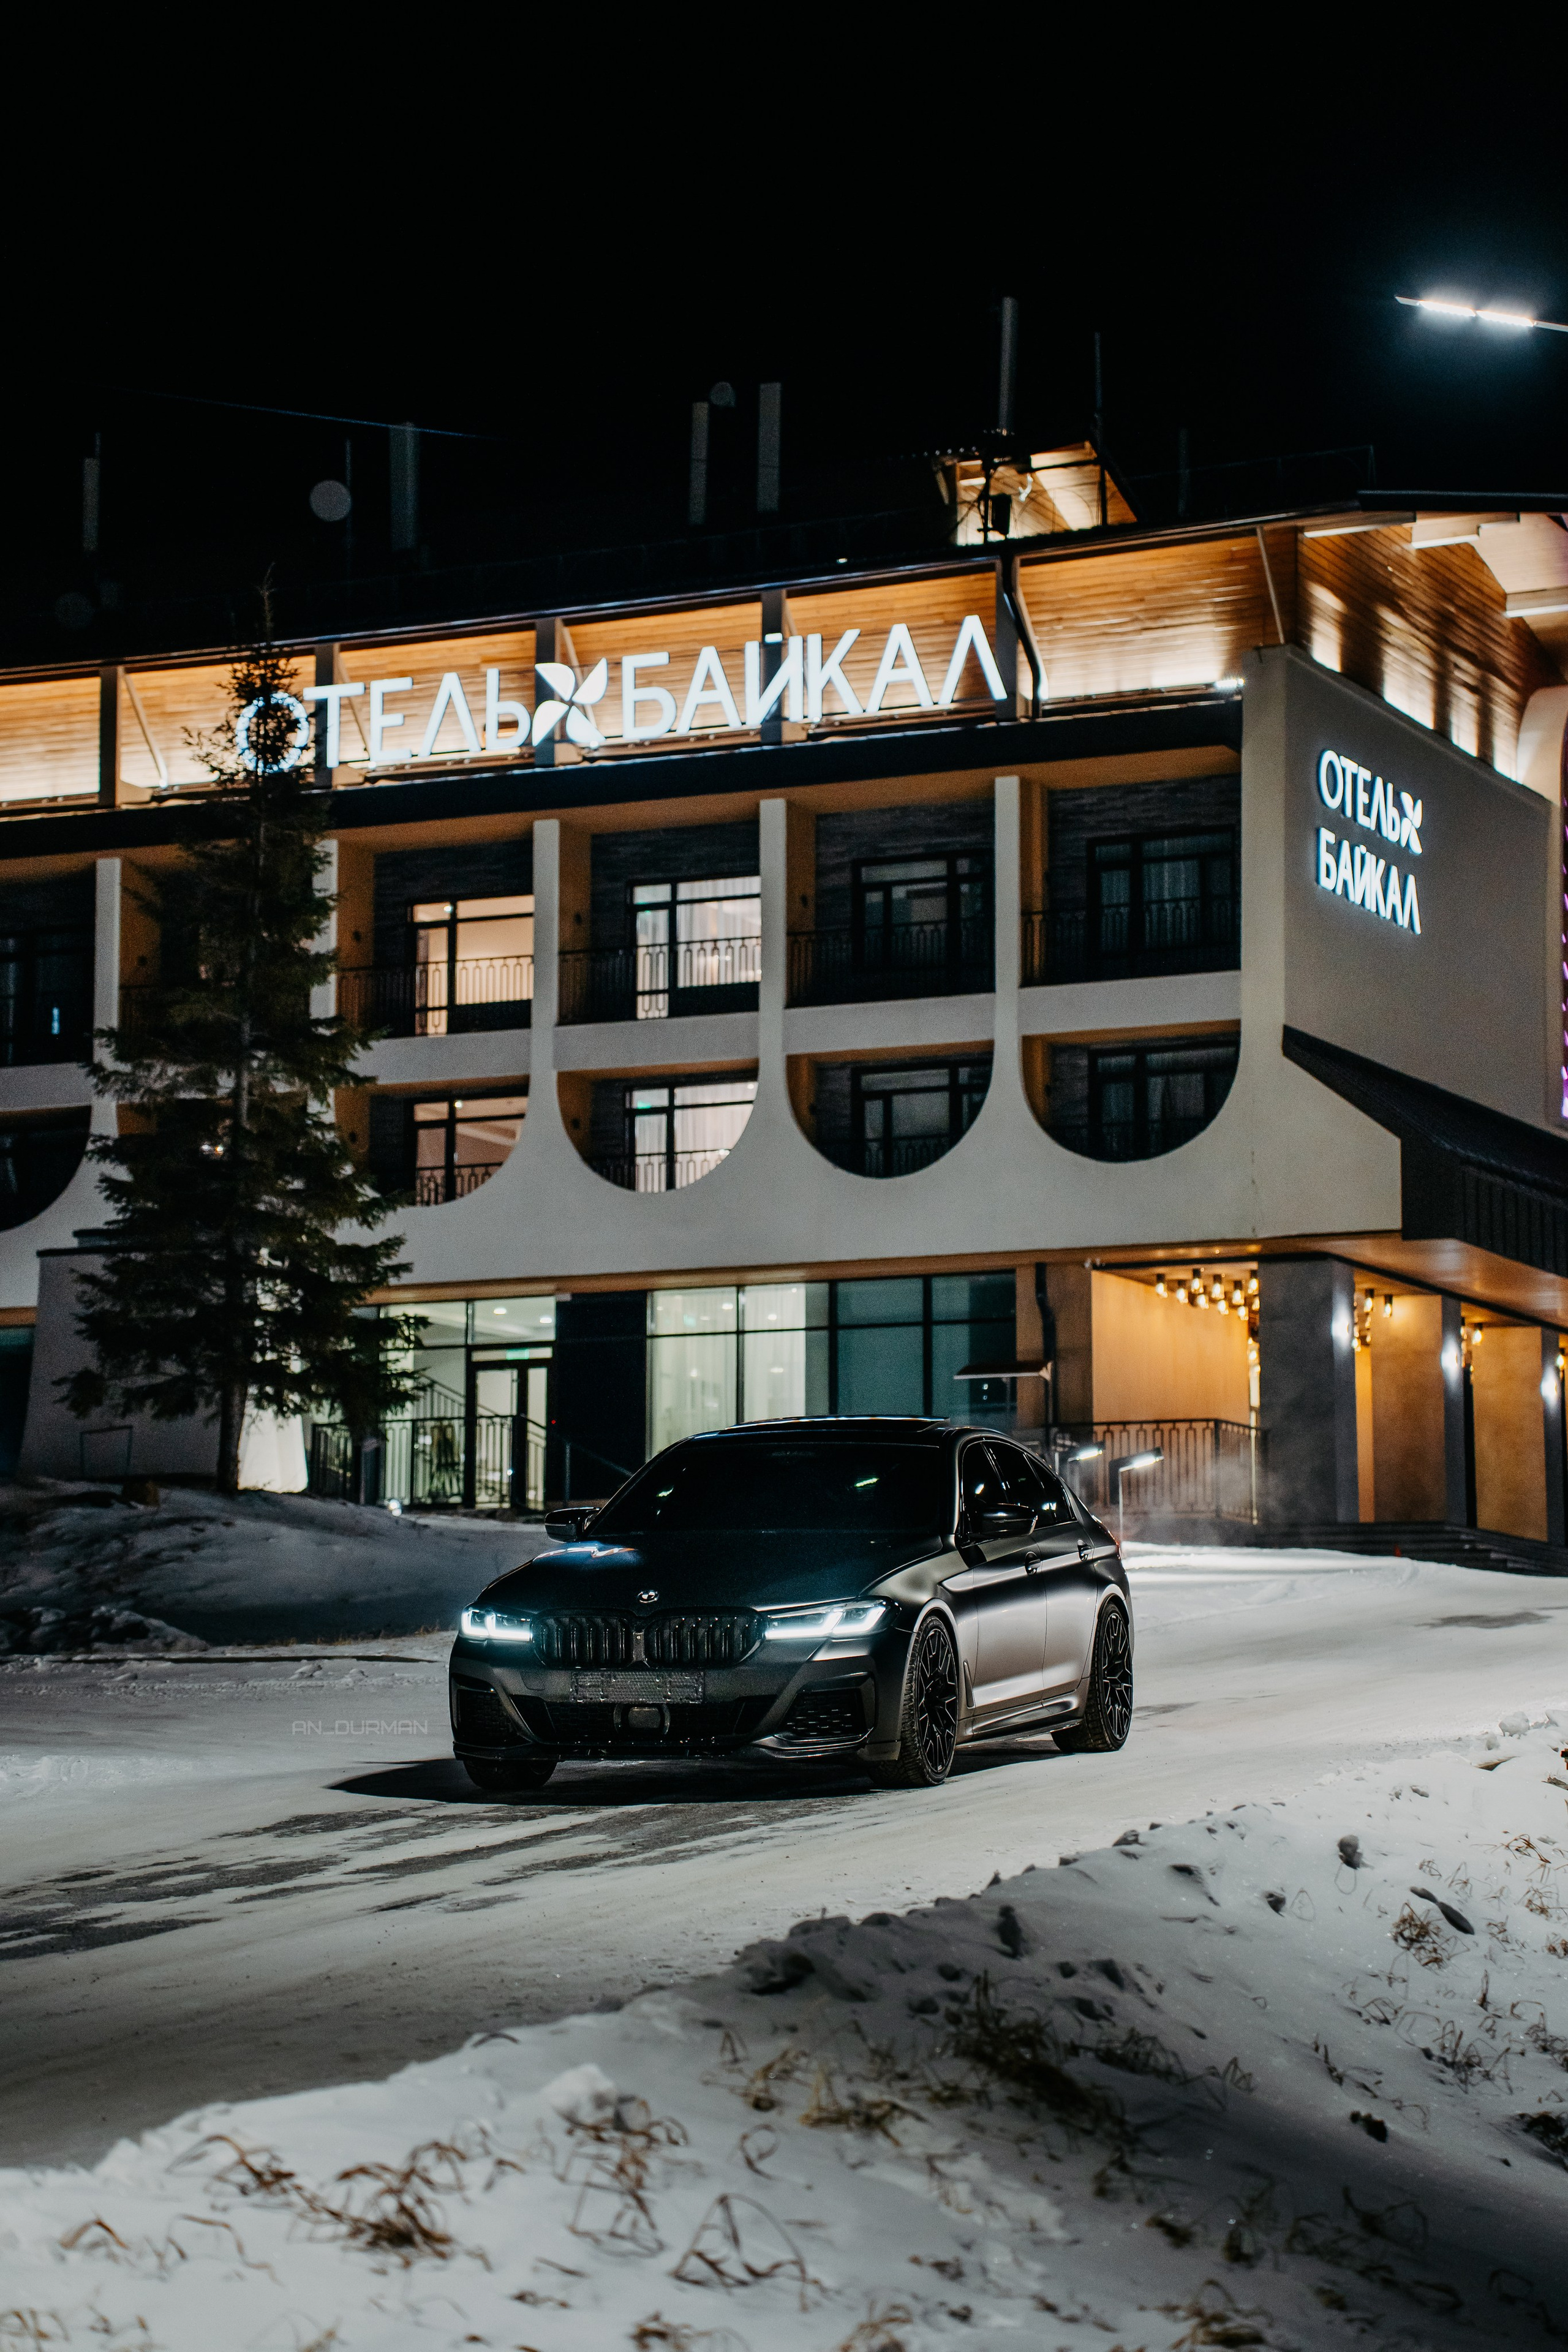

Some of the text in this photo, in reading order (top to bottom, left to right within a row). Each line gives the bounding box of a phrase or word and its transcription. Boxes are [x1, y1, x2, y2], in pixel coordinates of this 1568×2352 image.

[235, 614, 1008, 774] ОТЕЛЬ БАЙКАЛ
[1319, 750, 1401, 843] ОТЕЛЬ
[1319, 827, 1422, 935] БАЙКАЛ
